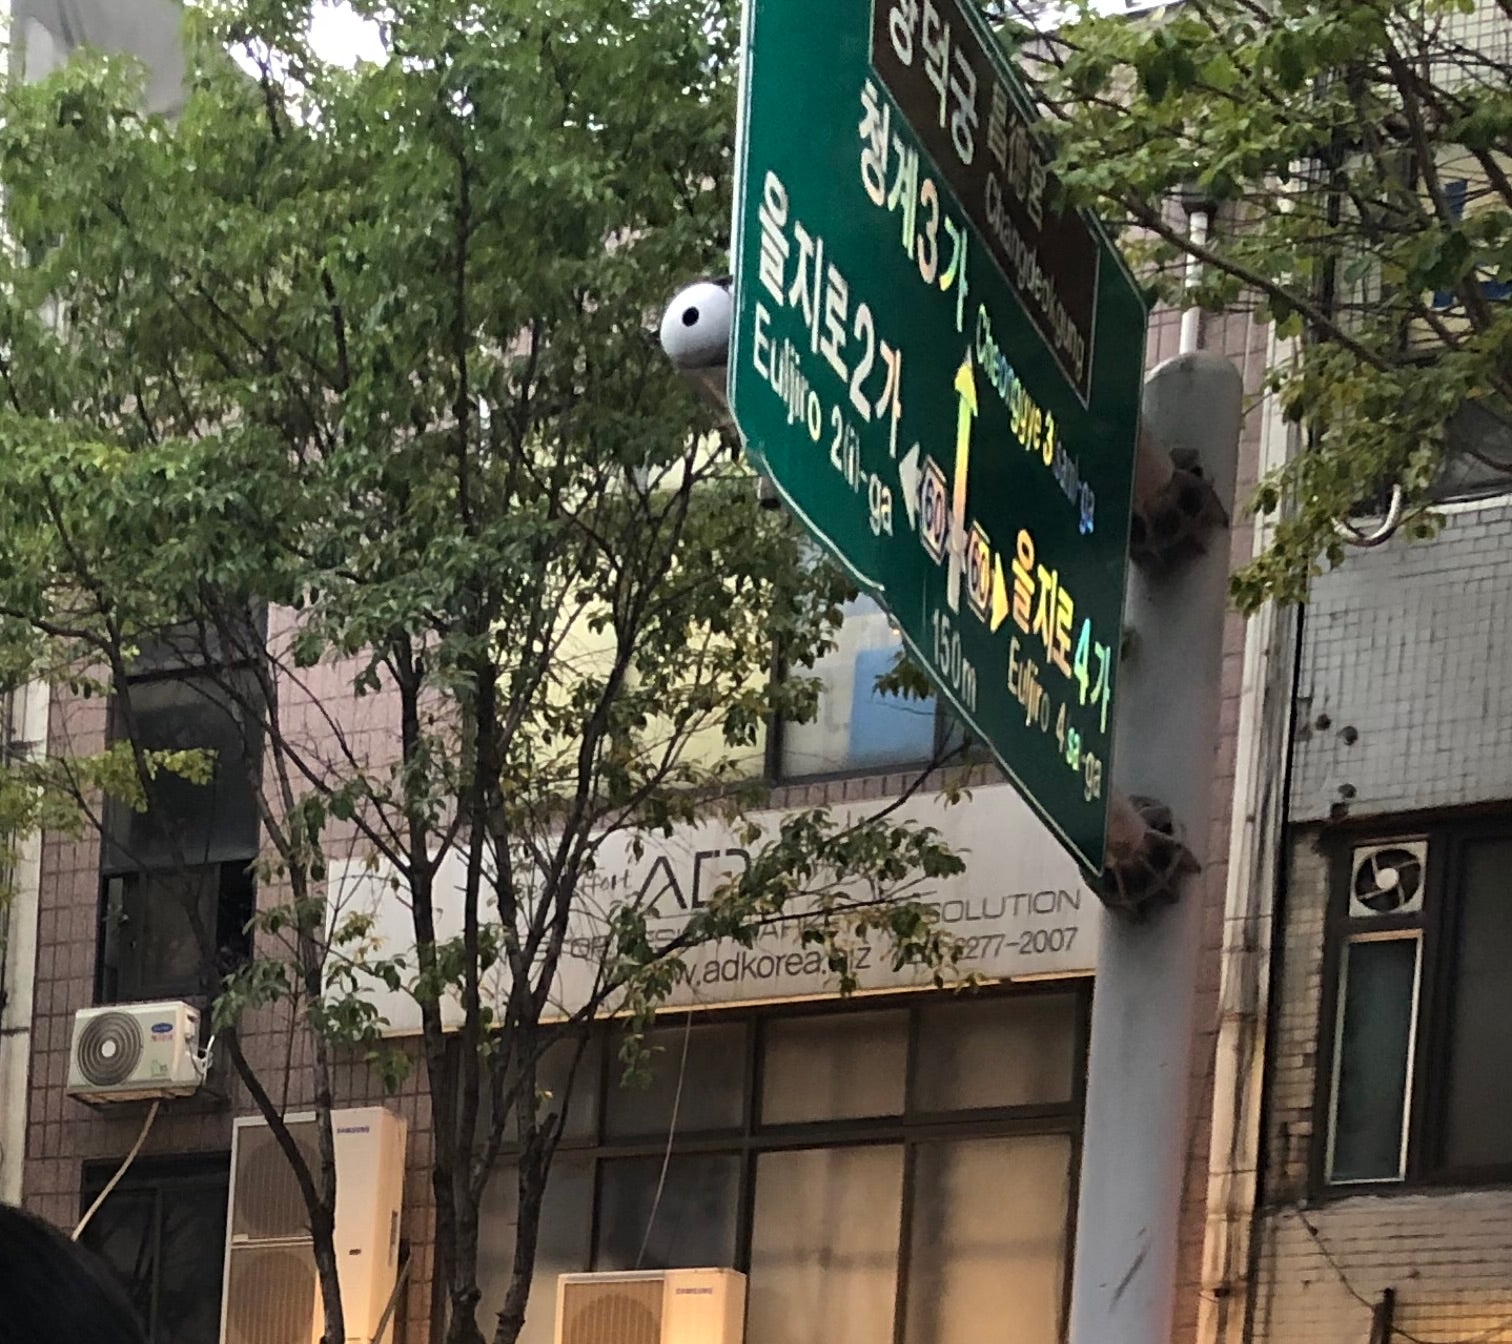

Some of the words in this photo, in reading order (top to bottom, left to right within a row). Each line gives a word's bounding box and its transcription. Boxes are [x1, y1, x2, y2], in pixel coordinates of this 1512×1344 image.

[859, 78, 968, 333] 청계3가
[758, 170, 901, 458] 을지로2가
[987, 172, 1085, 382] Changdeokgung
[754, 302, 821, 442] Euljiro
[932, 608, 977, 713] 150m
[1007, 635, 1050, 732] Euljiro
[1012, 529, 1111, 734] 을지로4가
[672, 945, 872, 985] w.adkorea.iz
[934, 888, 1082, 924] SOLUTION
